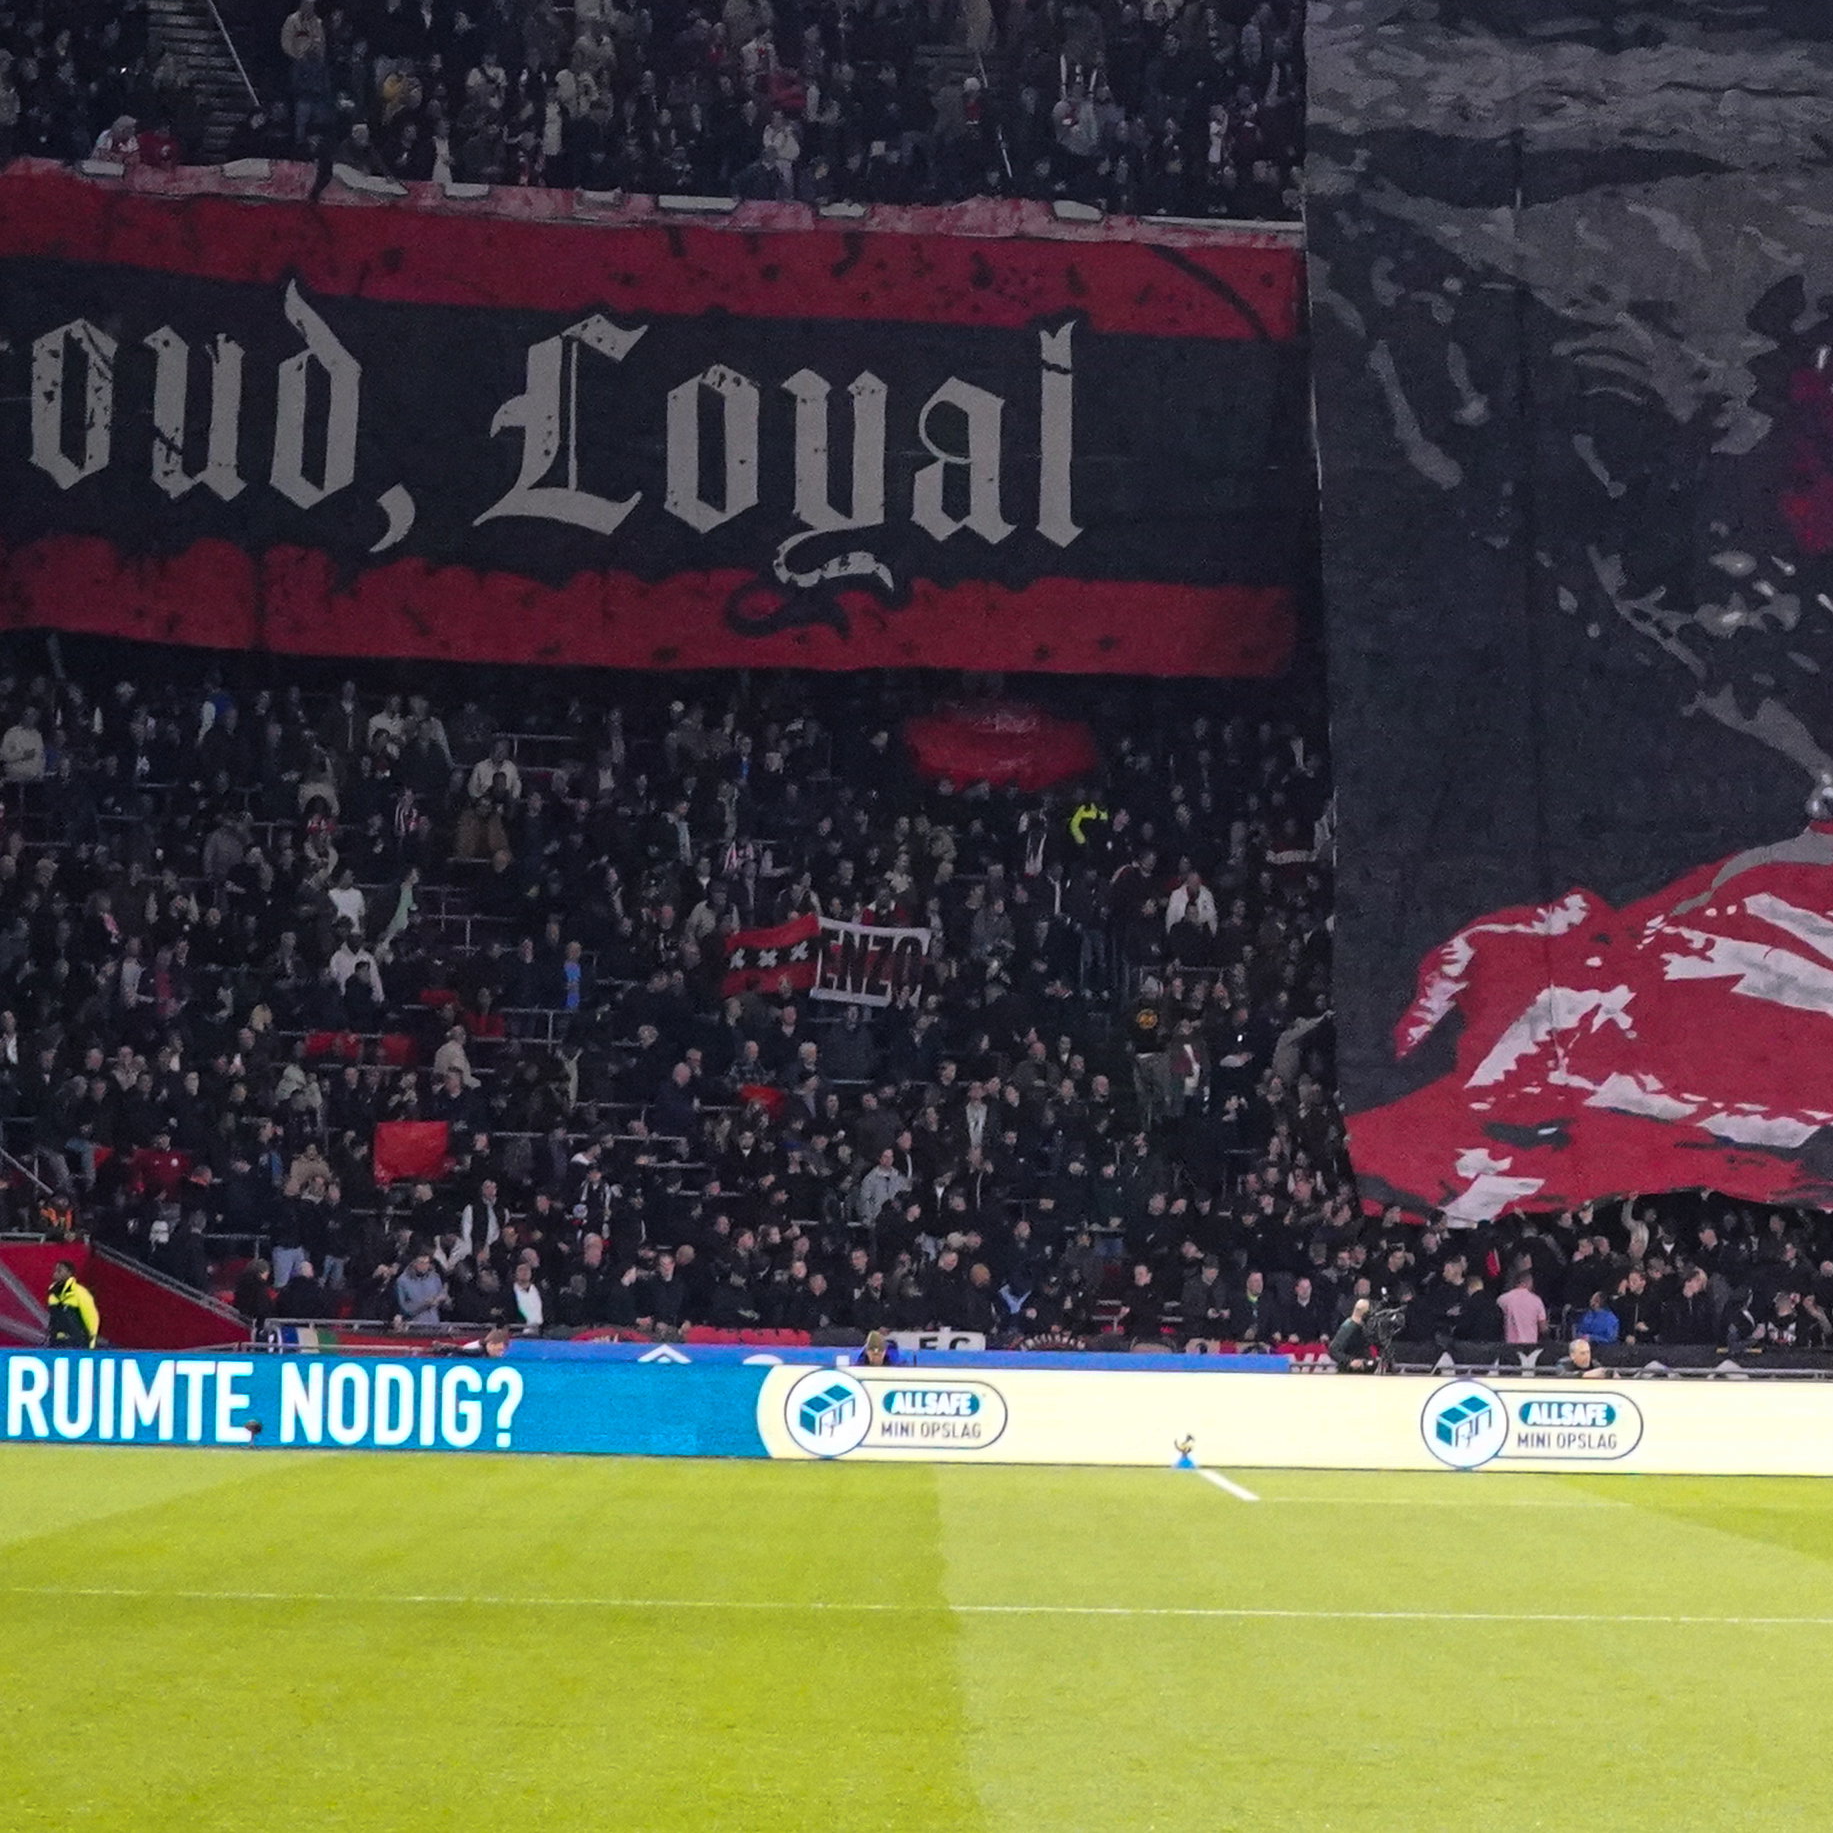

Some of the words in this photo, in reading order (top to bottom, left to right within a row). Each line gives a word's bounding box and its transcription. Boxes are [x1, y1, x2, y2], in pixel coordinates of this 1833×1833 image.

[0, 279, 418, 552] oud,
[472, 311, 1087, 593] Loyal
[822, 932, 923, 1002] ENZO
[7, 1355, 255, 1442] RUIMTE
[281, 1362, 523, 1448] NODIG?
[891, 1392, 972, 1416] ALLSAFE
[1527, 1402, 1610, 1427] ALLSAFE
[881, 1422, 915, 1438] MINI
[921, 1423, 981, 1439] OPSLAG
[1517, 1432, 1552, 1449] MINI
[1557, 1432, 1617, 1450] OPSLAG
